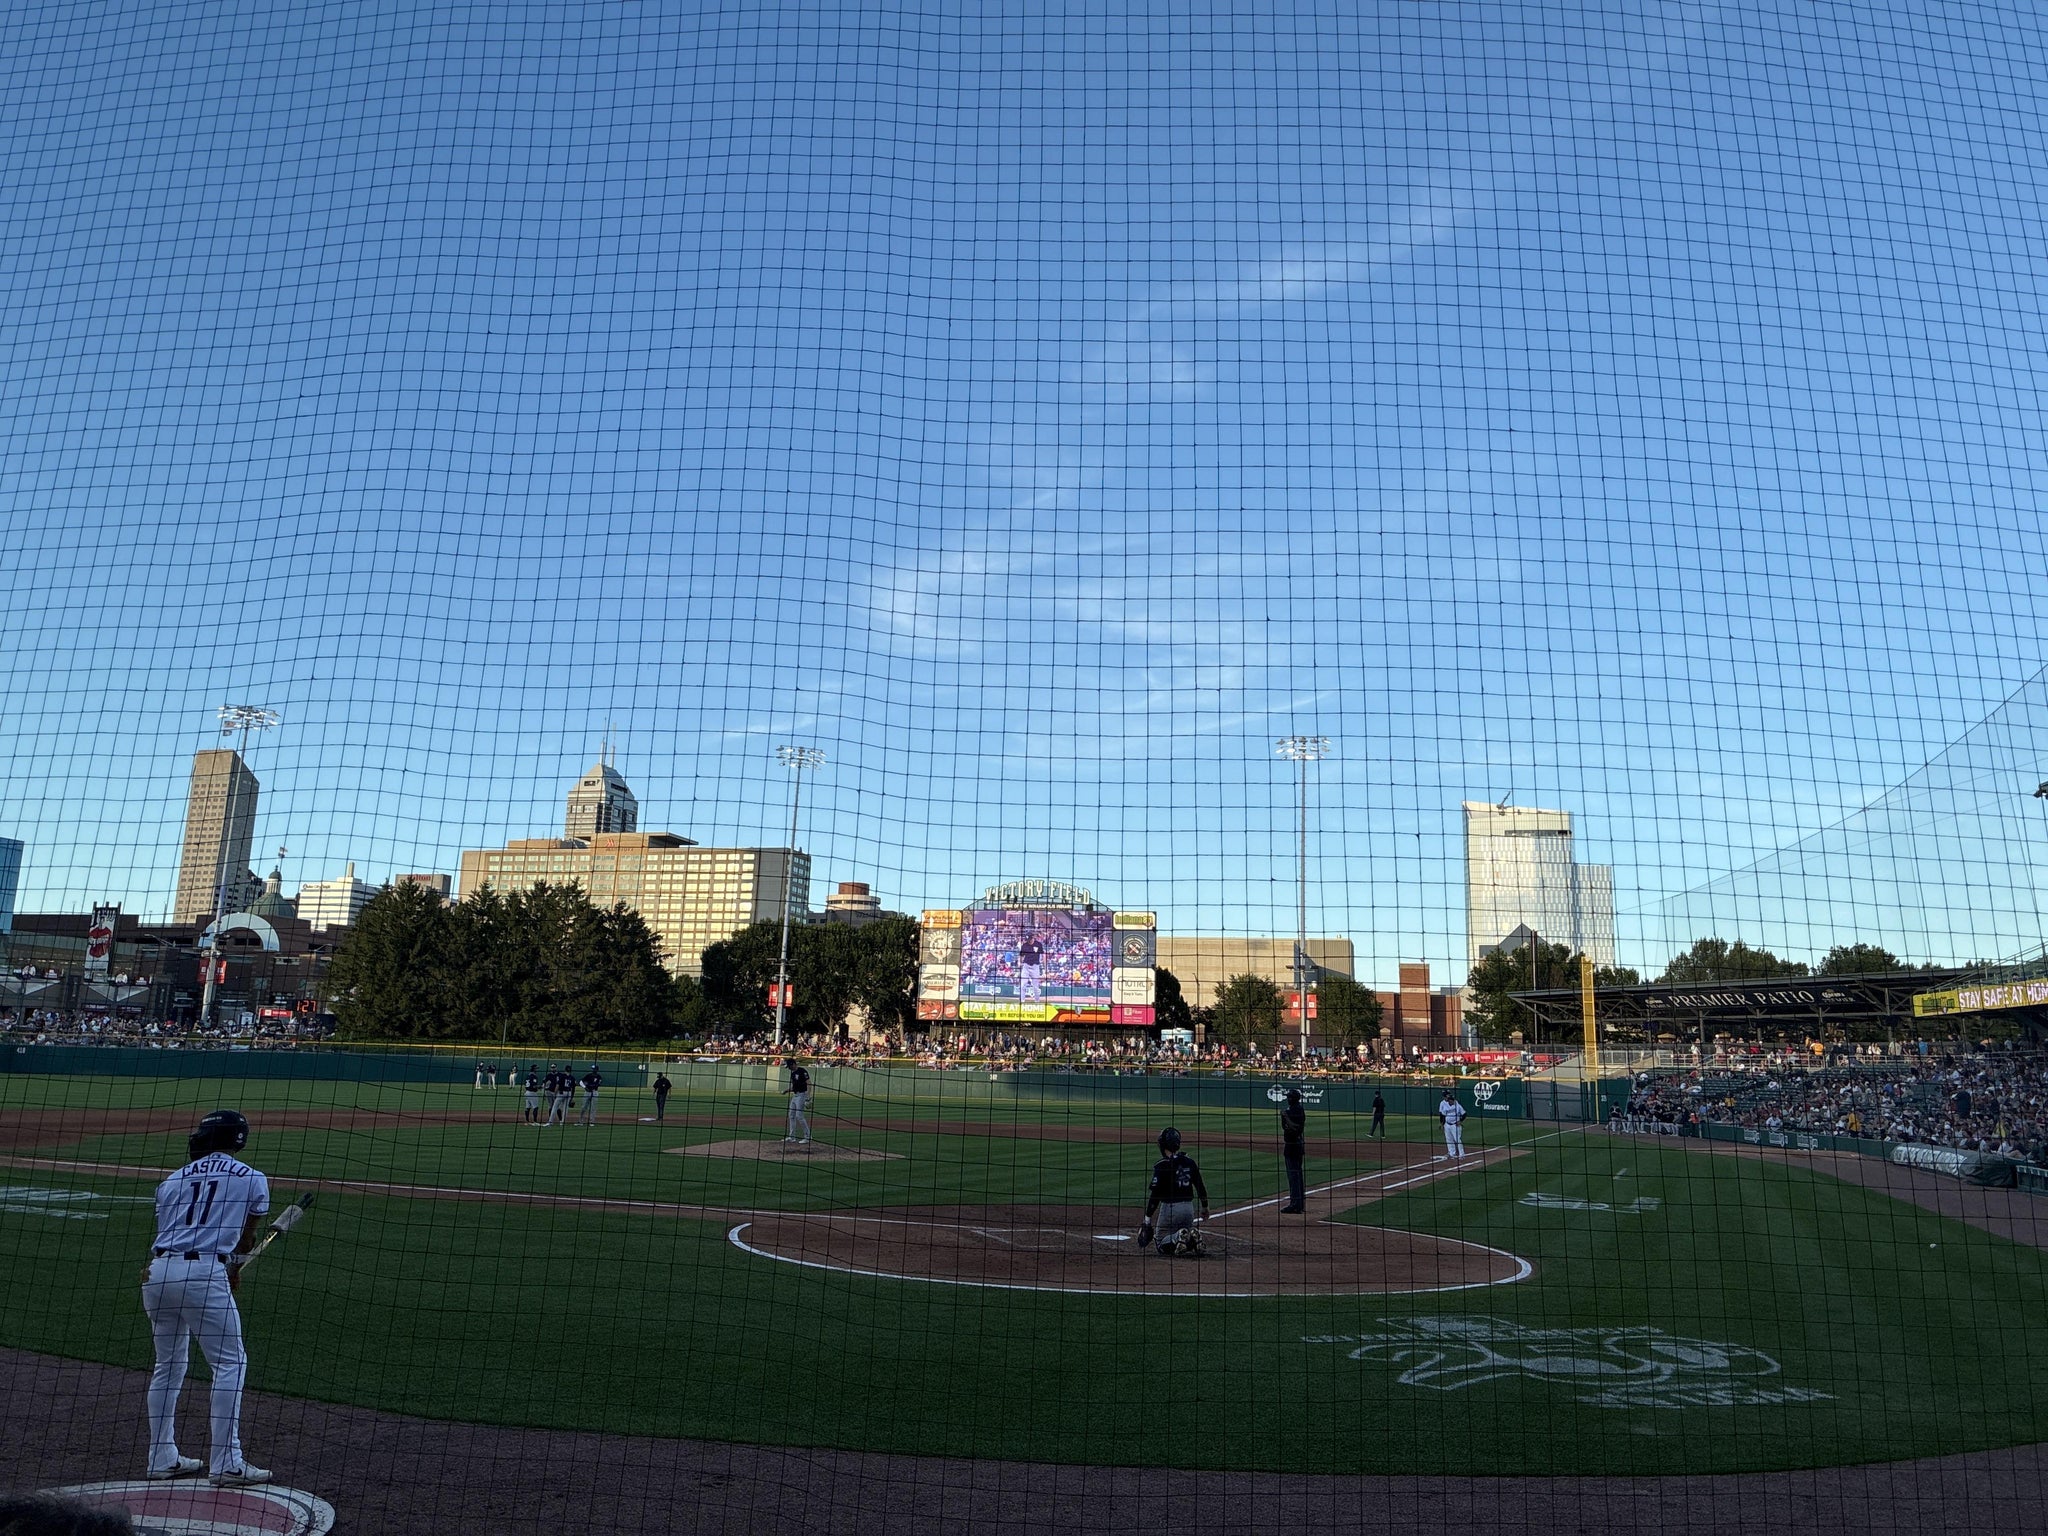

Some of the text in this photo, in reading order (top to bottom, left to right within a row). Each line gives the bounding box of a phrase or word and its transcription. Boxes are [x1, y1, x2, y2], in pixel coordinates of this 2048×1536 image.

[985, 879, 1091, 905] VICTORY FIELD
[1668, 990, 1816, 1007] PREMIER PATIO
[1959, 990, 1981, 1008] STAY
[1983, 987, 2009, 1007] SAFE
[2011, 985, 2023, 1004] AT
[963, 1001, 984, 1011] STAY
[986, 1003, 1007, 1011] SAFE
[1009, 1003, 1020, 1011] AT
[1021, 1004, 1045, 1012] HOME
[1484, 1103, 1510, 1111] Insurance
[183, 1160, 250, 1178] CASTILLO
[185, 1180, 219, 1225] 11
